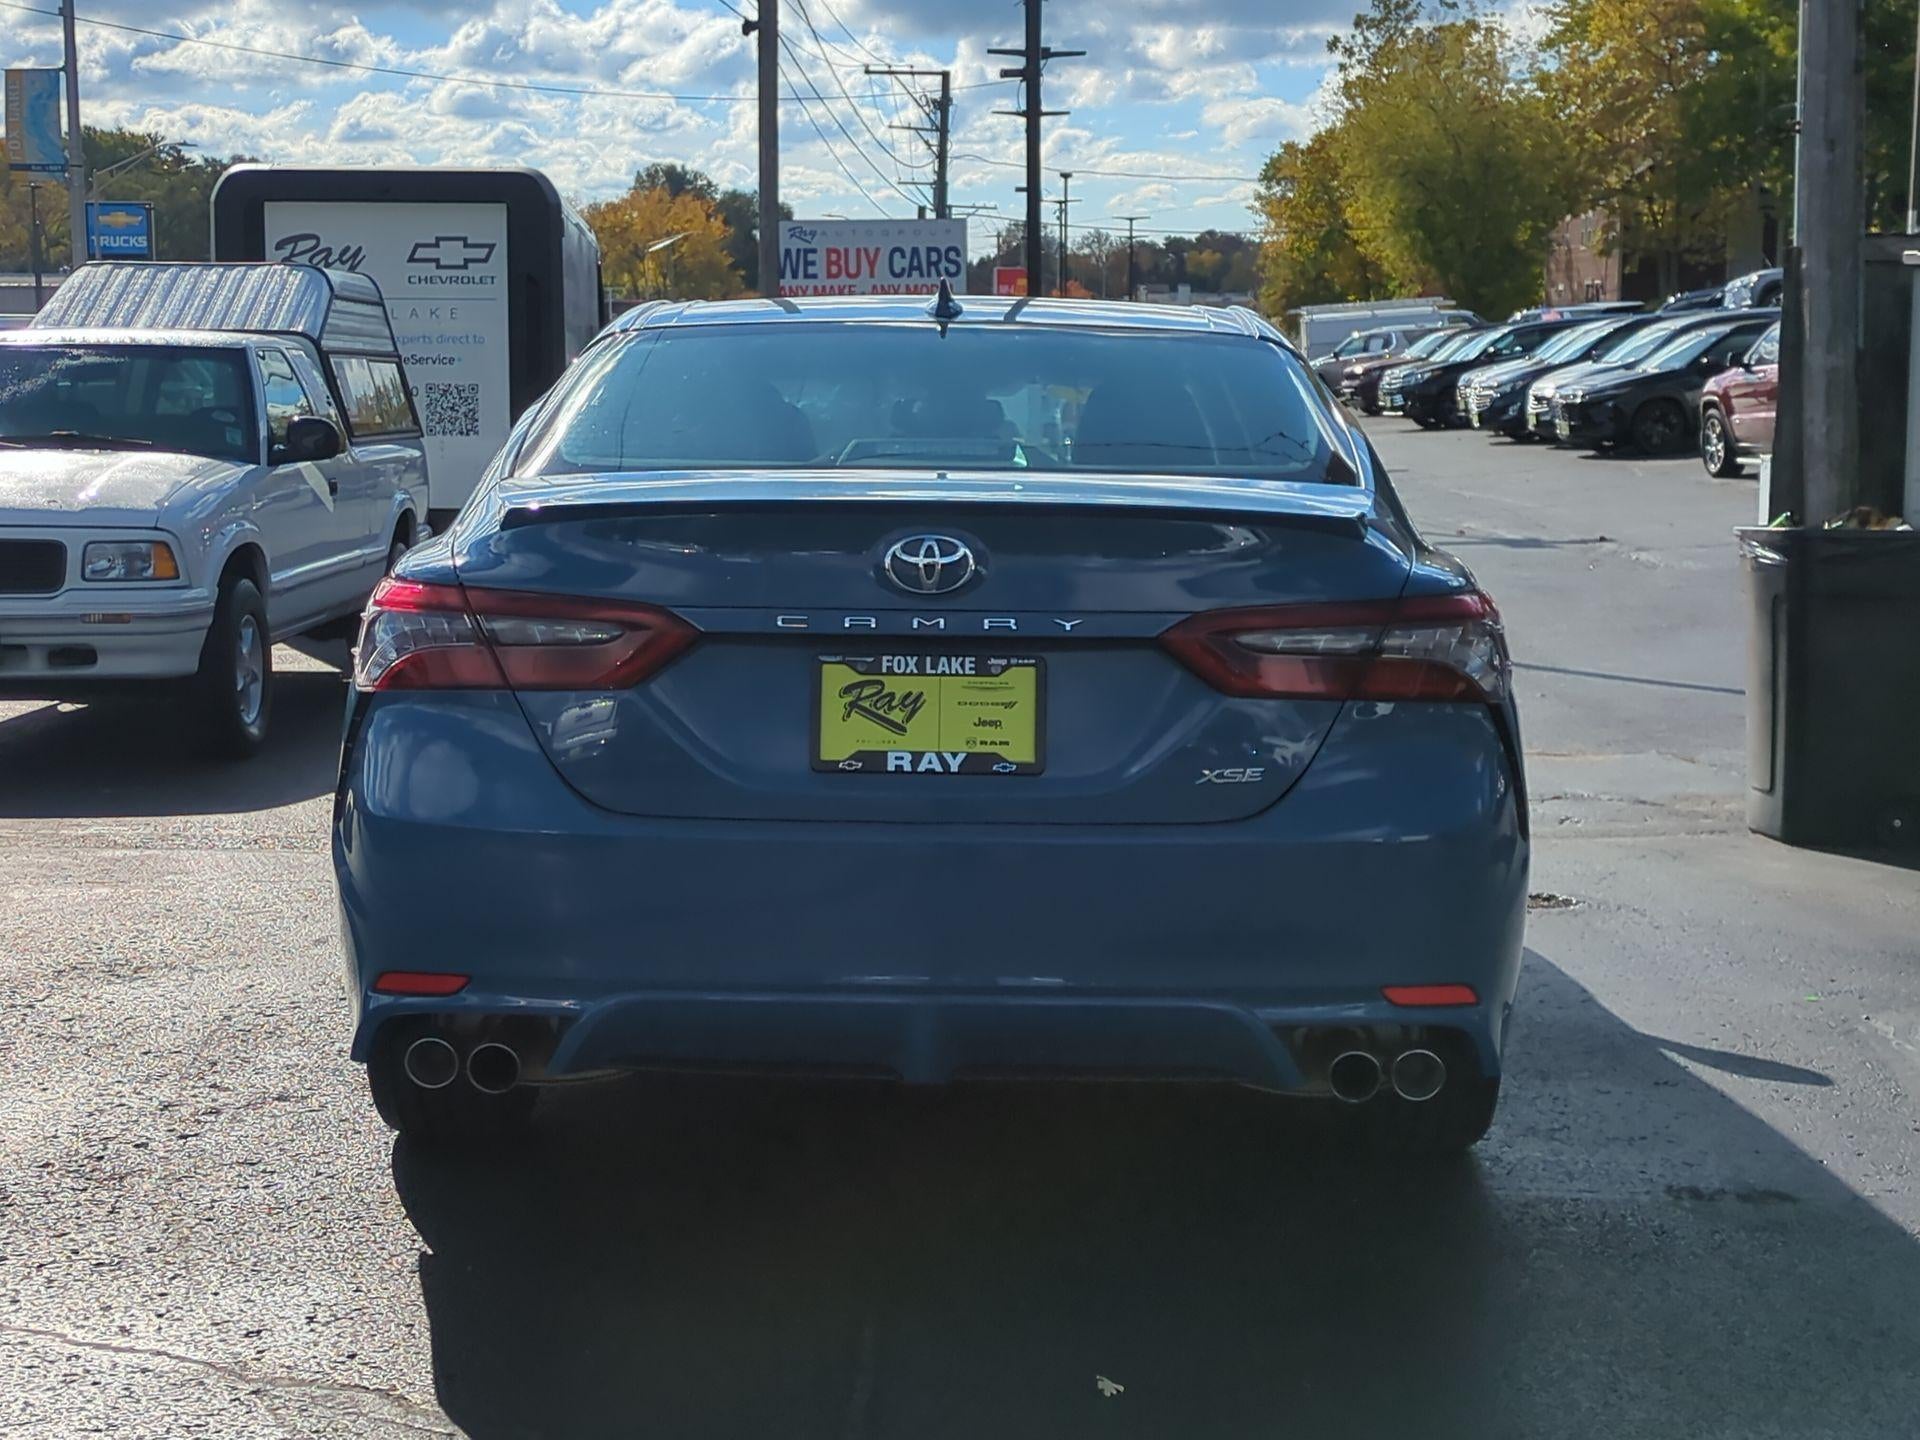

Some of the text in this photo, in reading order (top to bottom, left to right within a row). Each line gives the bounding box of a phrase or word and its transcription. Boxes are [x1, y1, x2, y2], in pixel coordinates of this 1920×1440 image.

[786, 225, 818, 244] Ray
[274, 233, 367, 273] Ray
[779, 246, 963, 280] WE BUY CARS
[407, 275, 497, 285] CHEVROLET
[814, 285, 857, 296] MAKE
[870, 284, 901, 296] ANY
[390, 307, 459, 320] LAKE
[396, 333, 486, 345] xperts direct to
[402, 353, 456, 366] eService
[776, 615, 1084, 632] CAMRY
[881, 655, 976, 674] FOX LAKE
[838, 678, 927, 736] Ray
[973, 716, 1002, 730] Jeep
[887, 751, 968, 773] RAY
[1195, 767, 1265, 785] XSE
